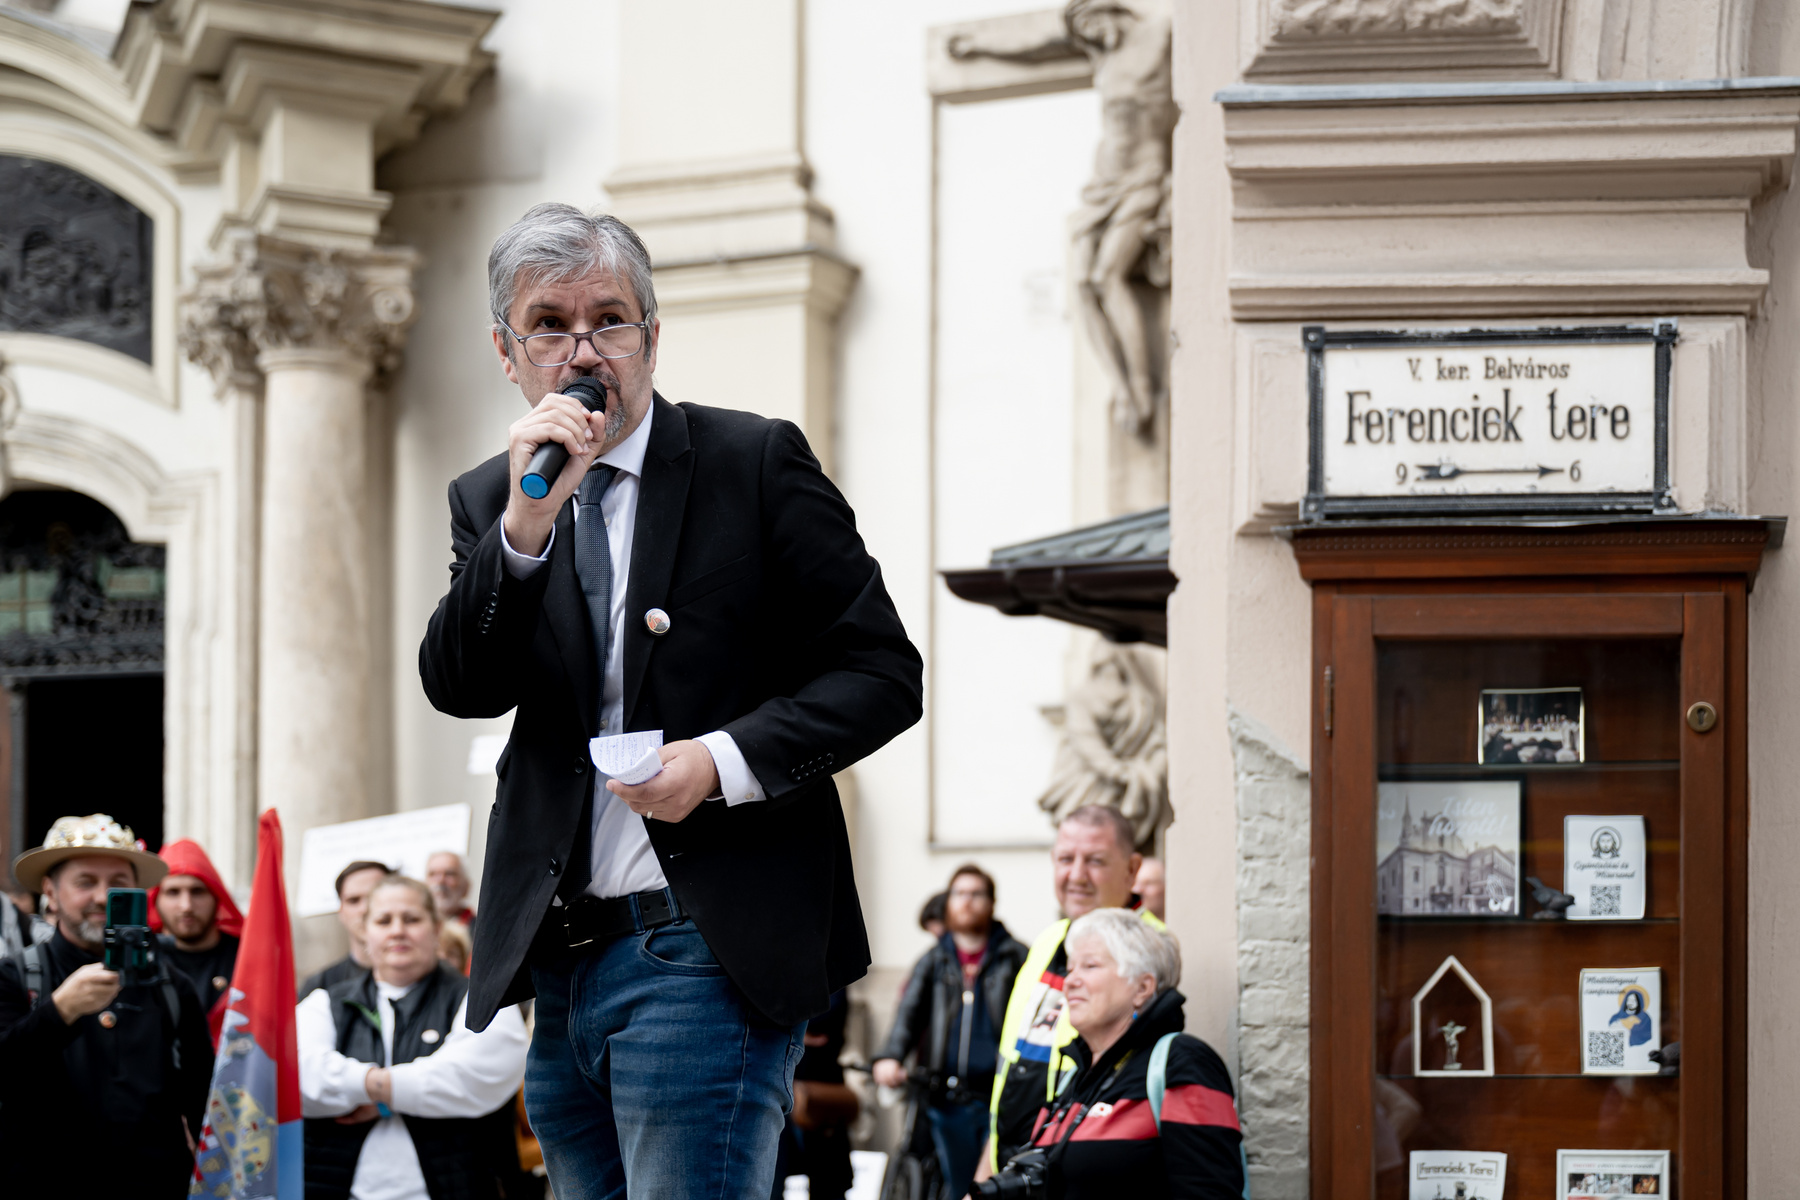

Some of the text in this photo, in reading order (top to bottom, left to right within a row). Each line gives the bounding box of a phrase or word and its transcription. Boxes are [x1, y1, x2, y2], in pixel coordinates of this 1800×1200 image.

[1407, 356, 1571, 381] V. ker. Belváros
[1344, 388, 1631, 444] Ferenciek tere
[1396, 460, 1582, 485] 9 6
[1442, 797, 1497, 817] Isten
[1428, 813, 1508, 837] hozott!
